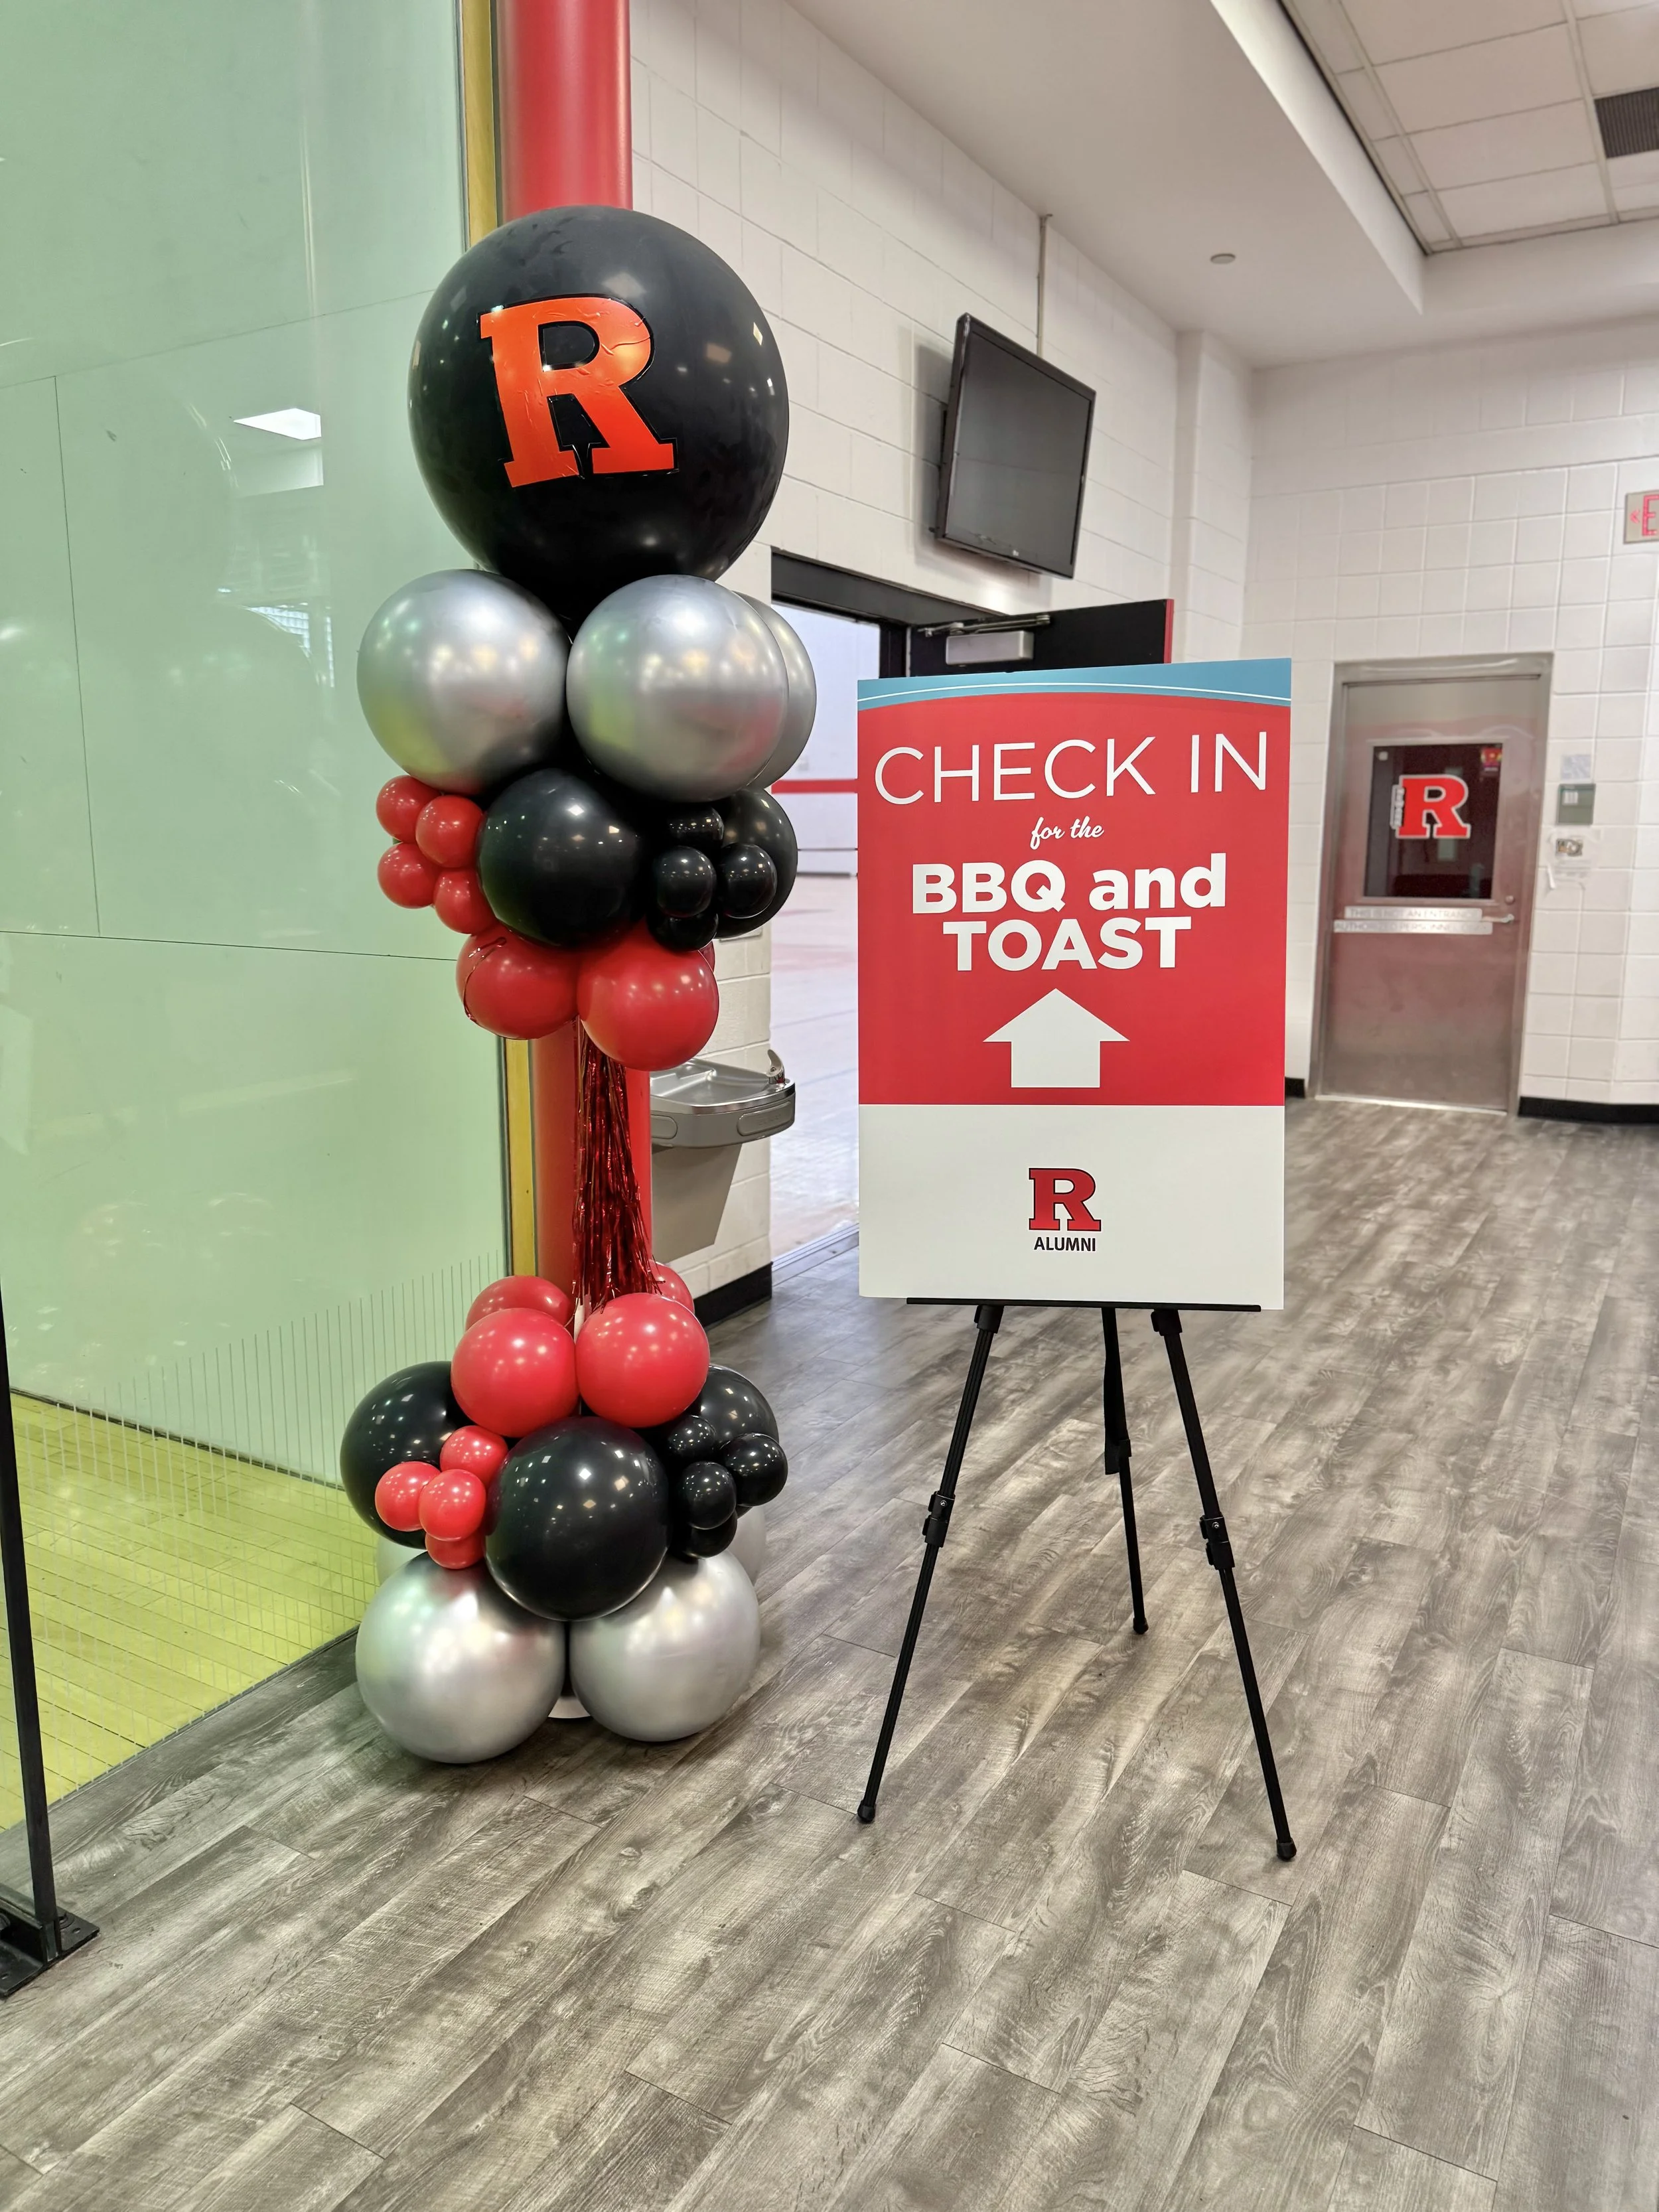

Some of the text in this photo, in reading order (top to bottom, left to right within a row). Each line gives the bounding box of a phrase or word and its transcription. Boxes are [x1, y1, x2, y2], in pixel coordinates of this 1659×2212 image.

[478, 294, 676, 488] R
[875, 732, 1266, 804] CHECK IN
[1030, 816, 1105, 849] for the
[1396, 774, 1471, 839] R
[913, 853, 1226, 913] BBQ and
[943, 917, 1192, 971] TOAST
[1029, 1167, 1102, 1231] R
[1034, 1236, 1096, 1252] ALUMNI
